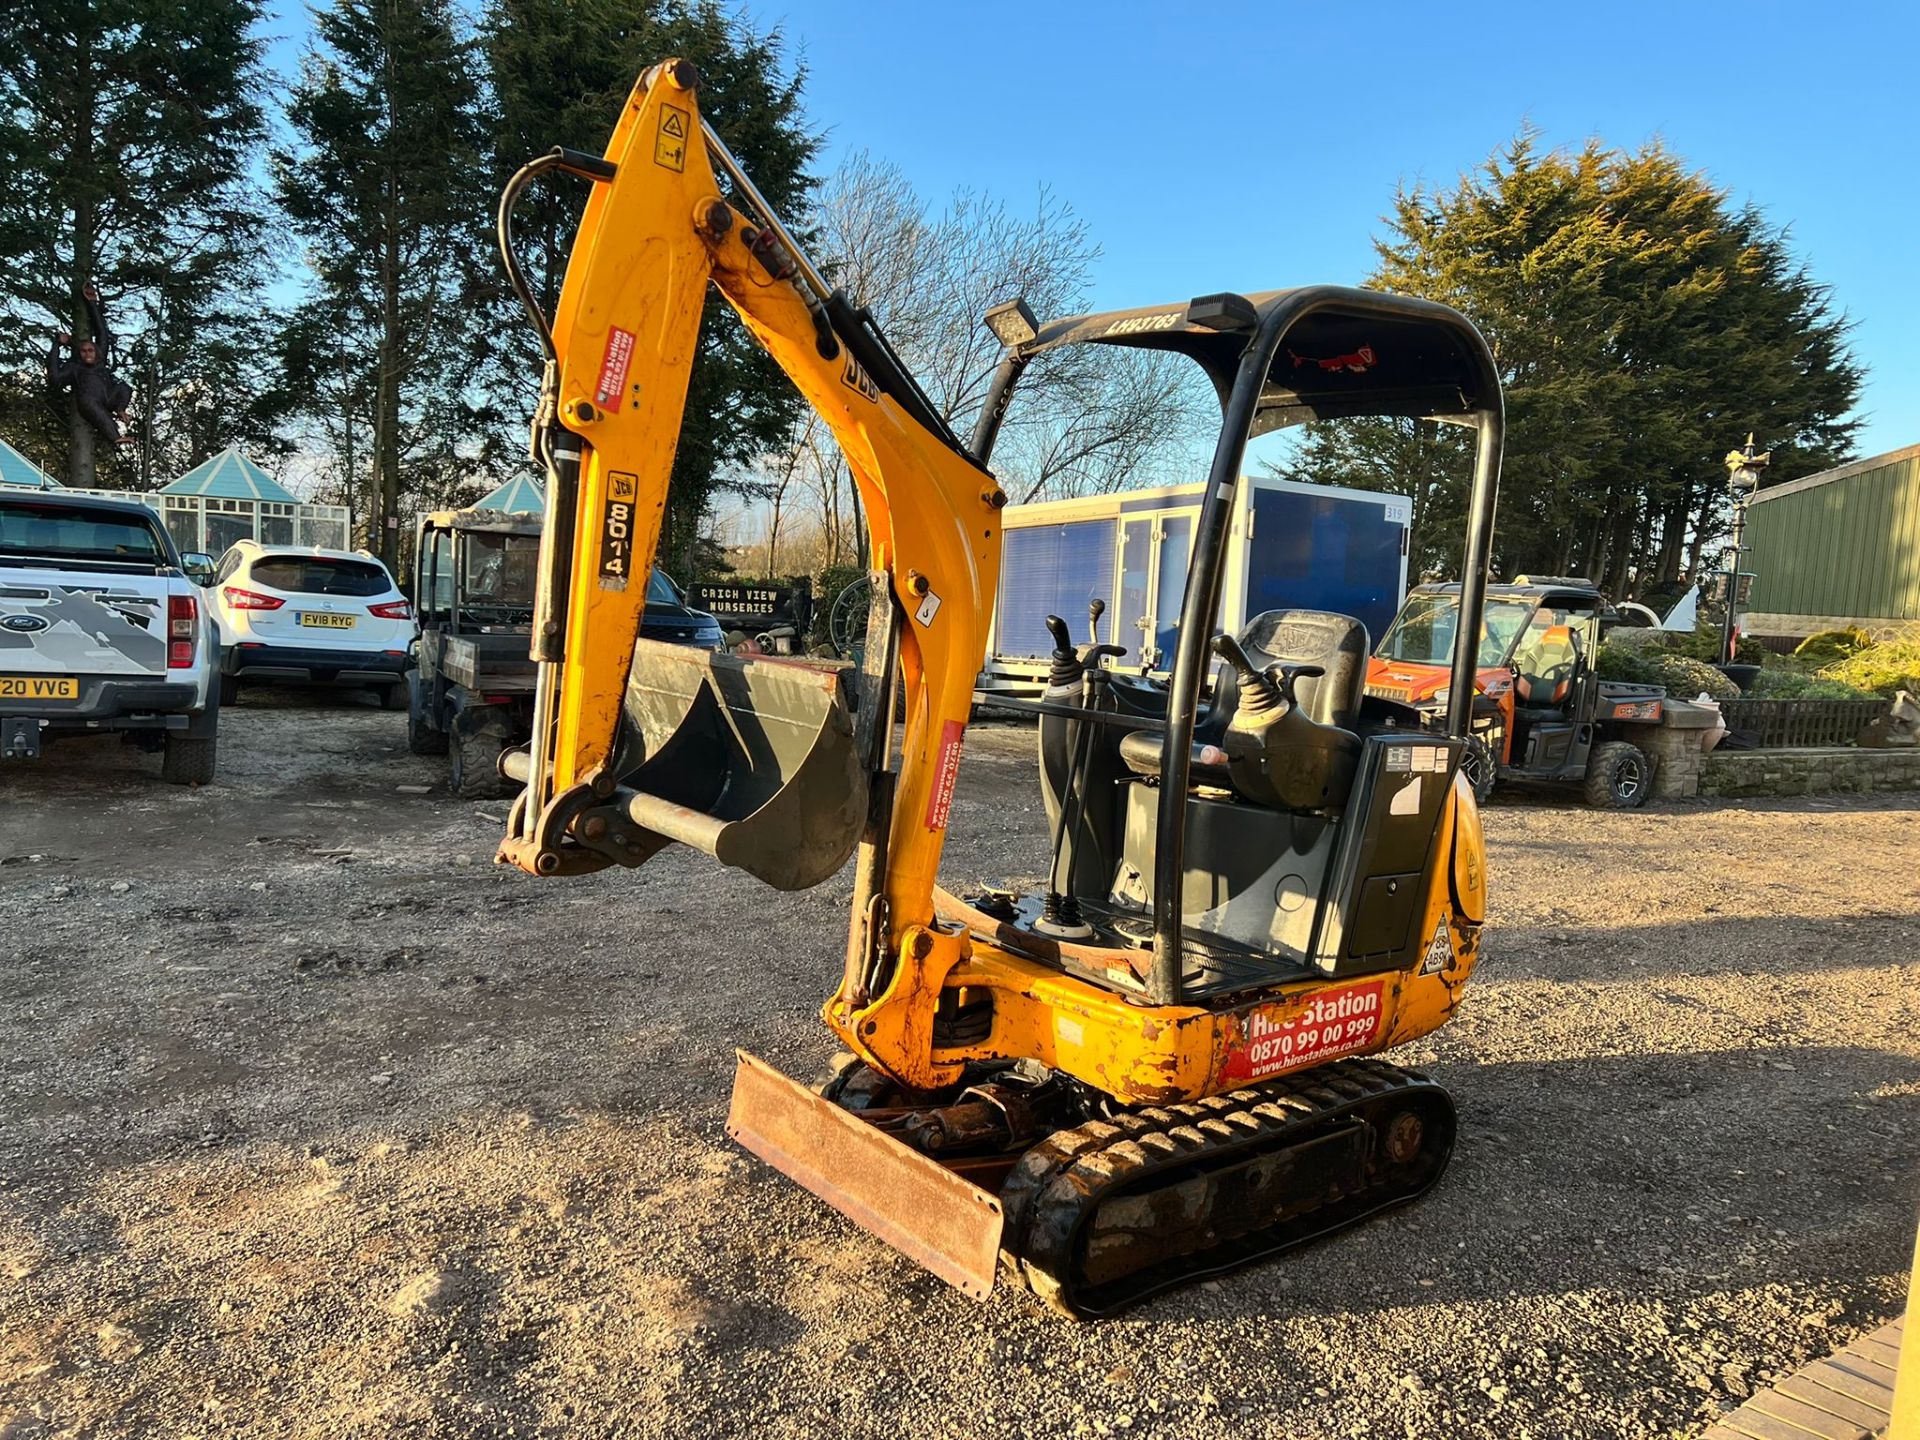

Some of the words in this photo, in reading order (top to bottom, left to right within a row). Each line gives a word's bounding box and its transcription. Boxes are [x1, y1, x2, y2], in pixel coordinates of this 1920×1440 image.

[615, 479, 633, 495] JCB
[606, 504, 628, 574] 8014
[701, 588, 739, 599] CRICH
[746, 590, 777, 601] VIEW
[709, 602, 774, 613] NURSERIES
[304, 614, 328, 625] FV18
[331, 615, 353, 627] RYG
[0, 679, 26, 695] 20
[33, 680, 69, 695] VVG
[1302, 991, 1377, 1026] Station
[1251, 1035, 1292, 1063] 0870
[1296, 1030, 1318, 1051] 99
[1322, 1024, 1343, 1044] 00
[1346, 1016, 1375, 1038] 999
[1251, 1035, 1367, 1076] www.hirestation.co.uk
